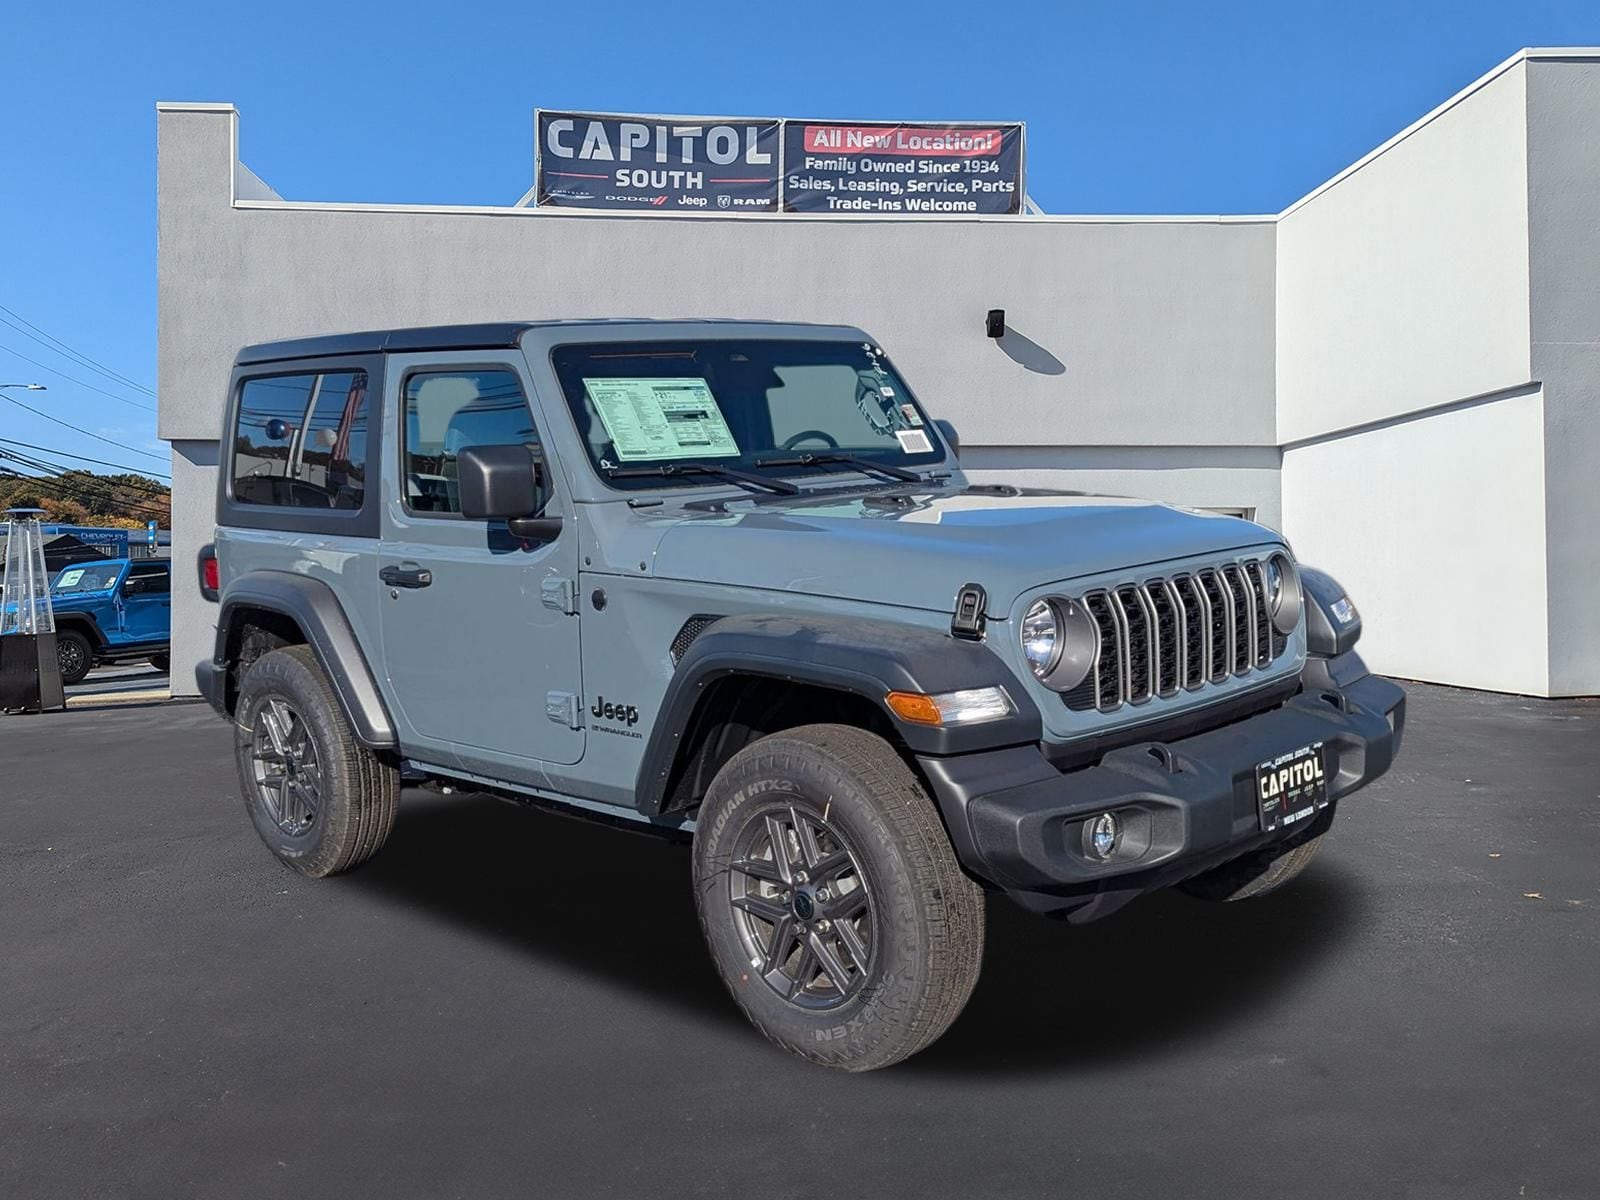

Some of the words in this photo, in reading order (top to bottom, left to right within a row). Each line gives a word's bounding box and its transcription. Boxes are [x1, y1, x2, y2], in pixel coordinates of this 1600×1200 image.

[547, 119, 771, 165] CAPITOL
[813, 129, 841, 148] All
[847, 131, 892, 149] New
[896, 131, 993, 151] Location!
[805, 157, 857, 174] Family
[860, 158, 915, 173] Owned
[918, 161, 960, 174] Since
[963, 160, 1000, 173] 1934
[615, 169, 703, 190] SOUTH
[789, 176, 835, 192] Sales,
[838, 177, 904, 195] Leasing,
[906, 179, 968, 195] Service,
[971, 179, 1015, 192] Parts
[678, 195, 708, 207] Jeep
[827, 196, 902, 211] Trade-Ins
[905, 198, 977, 211] Welcome
[591, 695, 639, 727] Jeep
[1260, 756, 1324, 800] CAPITOL
